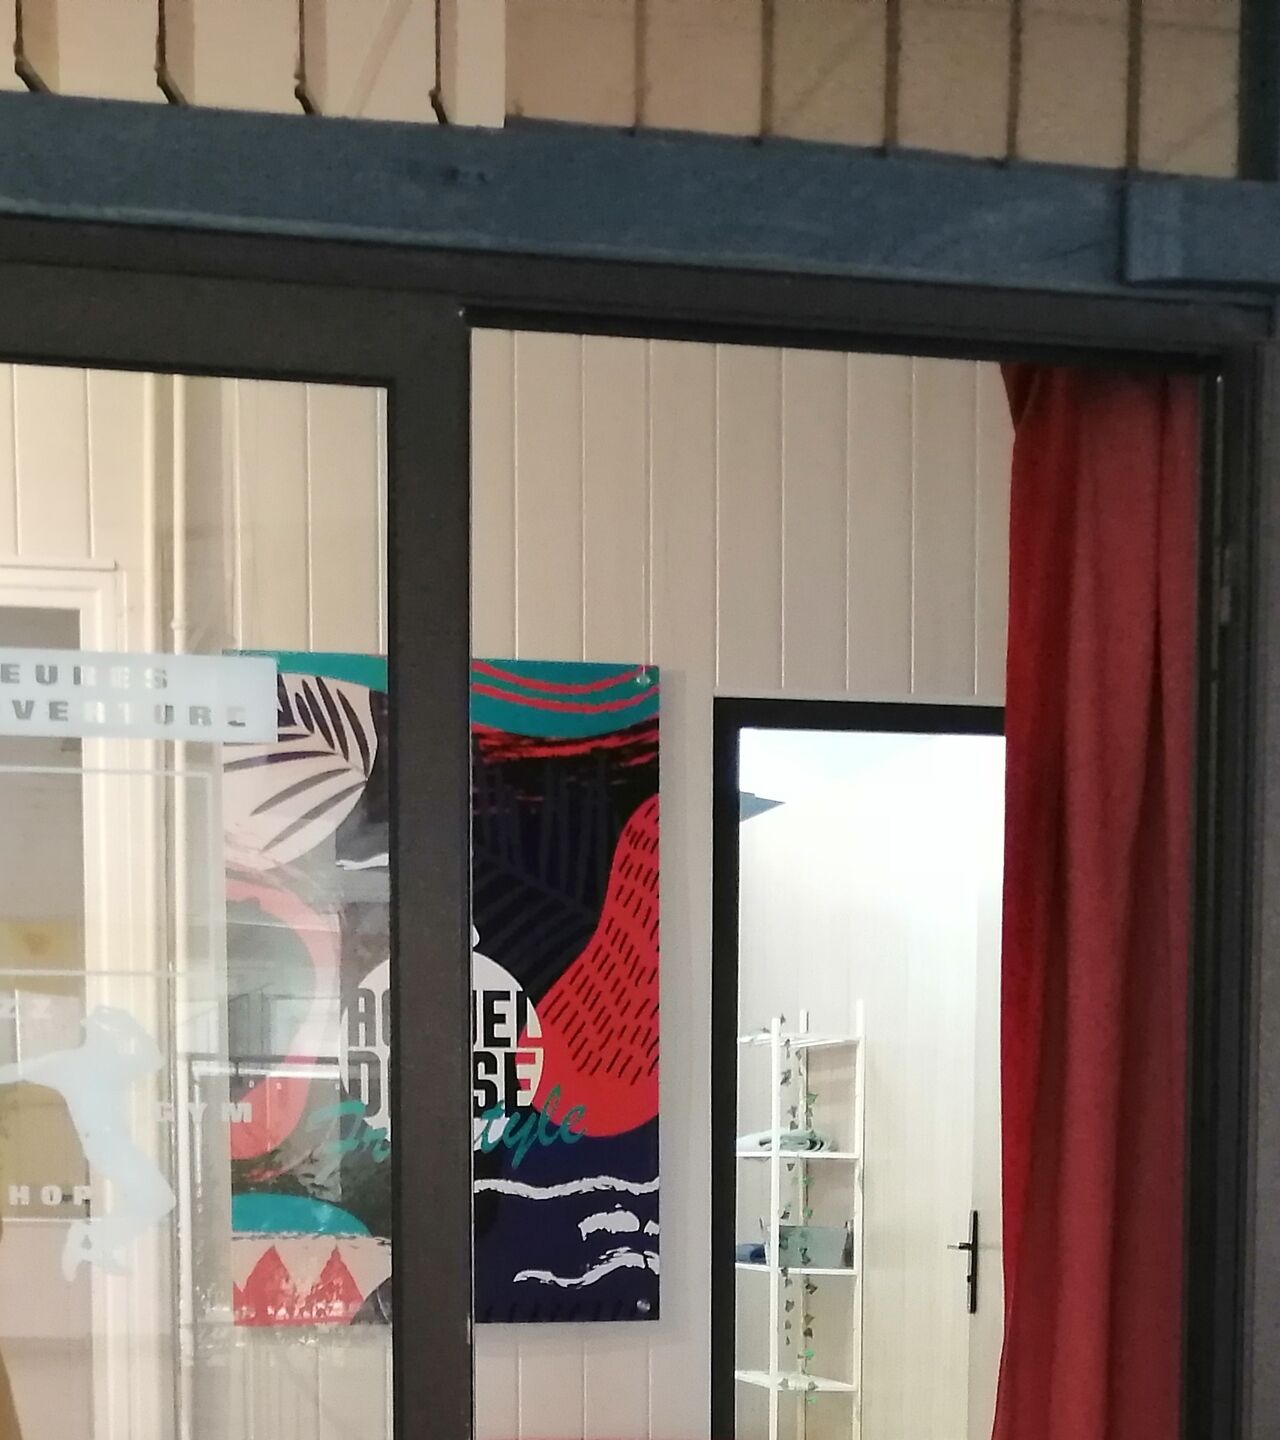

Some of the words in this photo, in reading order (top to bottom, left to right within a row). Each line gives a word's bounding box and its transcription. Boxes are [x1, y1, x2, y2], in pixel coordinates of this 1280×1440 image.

[342, 1050, 542, 1118] DSE
[155, 1101, 253, 1123] GYM
[7, 1184, 97, 1207] HOP
